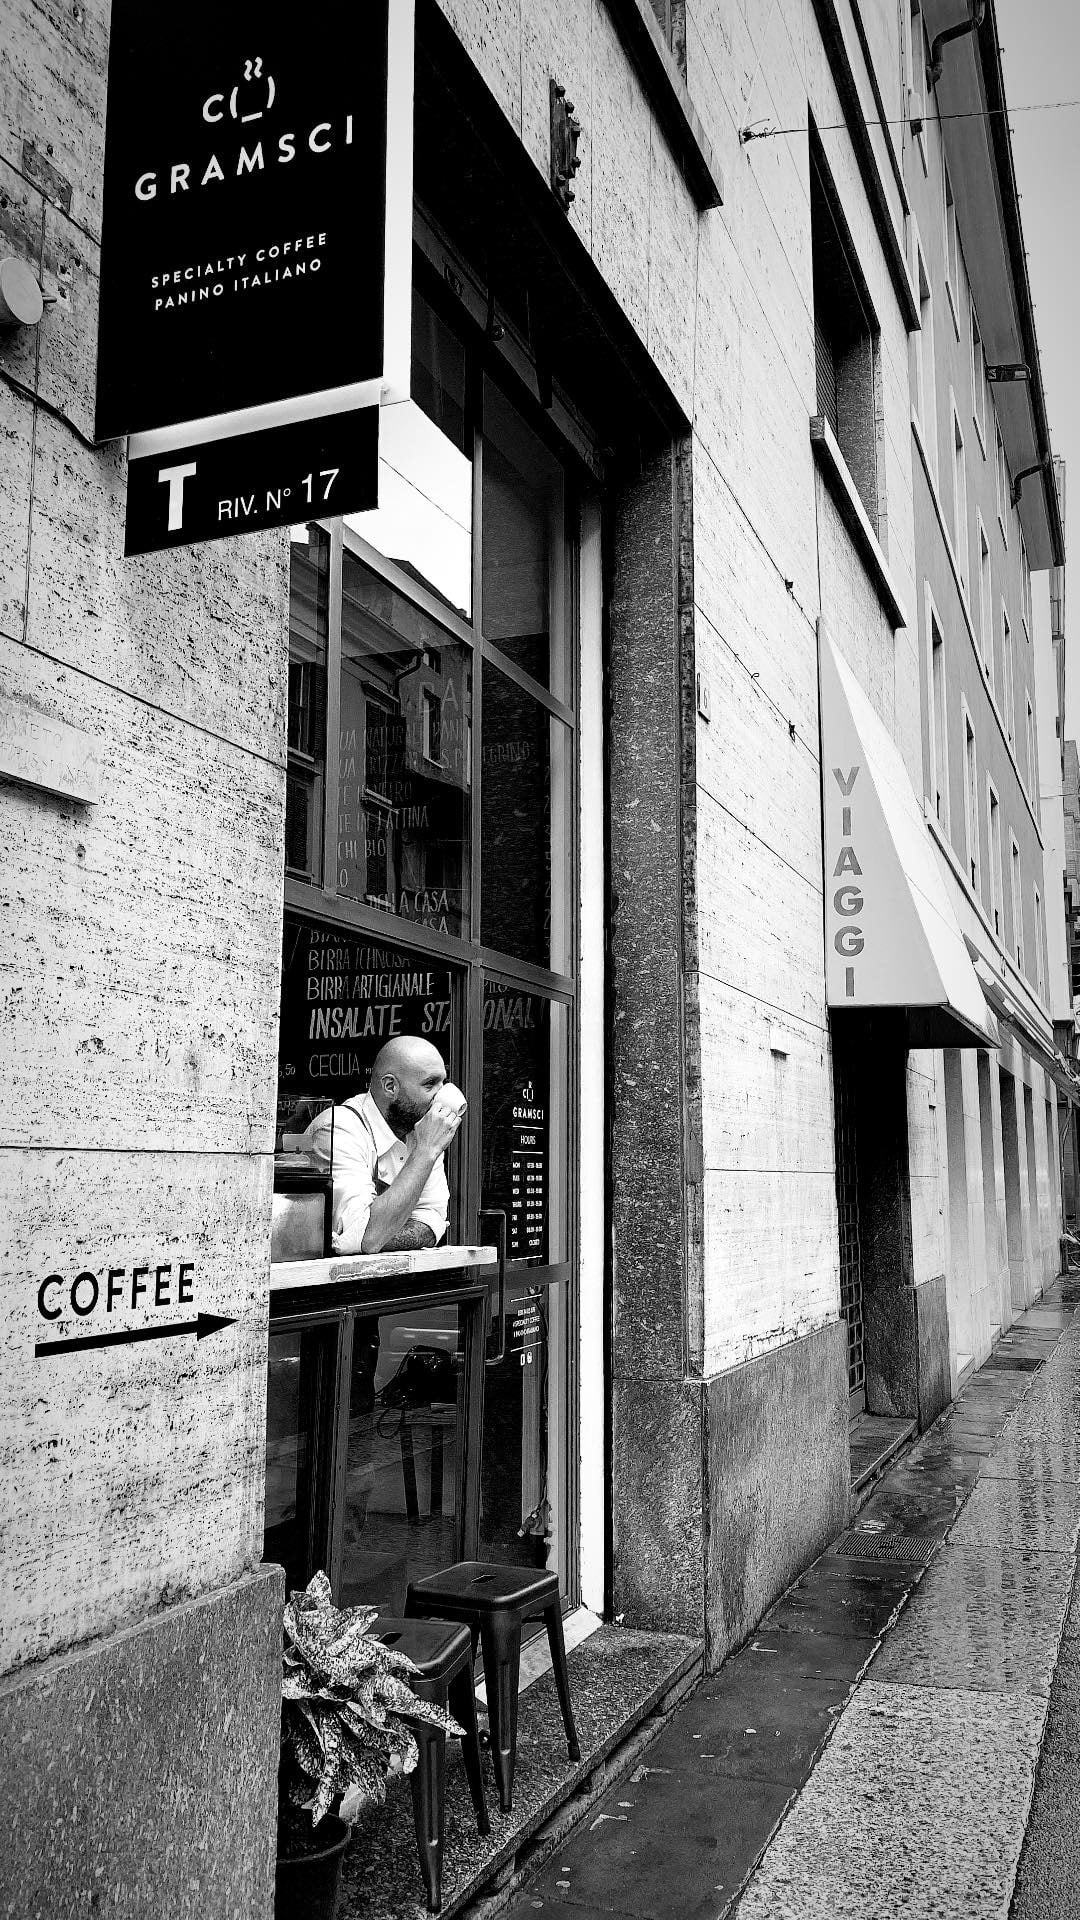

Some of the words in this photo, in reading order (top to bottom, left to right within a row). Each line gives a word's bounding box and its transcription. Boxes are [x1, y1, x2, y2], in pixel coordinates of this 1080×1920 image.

[134, 114, 353, 200] GRAMSCI
[151, 252, 247, 288] SPECIALTY
[255, 232, 328, 263] COFFEE
[154, 282, 225, 311] PANINO
[234, 258, 322, 291] ITALIANO
[158, 461, 197, 531] T
[217, 488, 259, 521] RIV.
[301, 468, 339, 504] 17
[415, 889, 450, 912] CASA
[832, 766, 864, 997] VIAGGI
[307, 975, 350, 1001] BIRRA
[352, 972, 435, 999] ARTIGIANALE
[309, 1004, 403, 1039] INSALATE
[309, 1053, 362, 1078] CECILIA
[513, 1106, 544, 1120] GRAMSCI
[520, 1135, 536, 1145] HOURS
[37, 1263, 195, 1320] COFFEE
